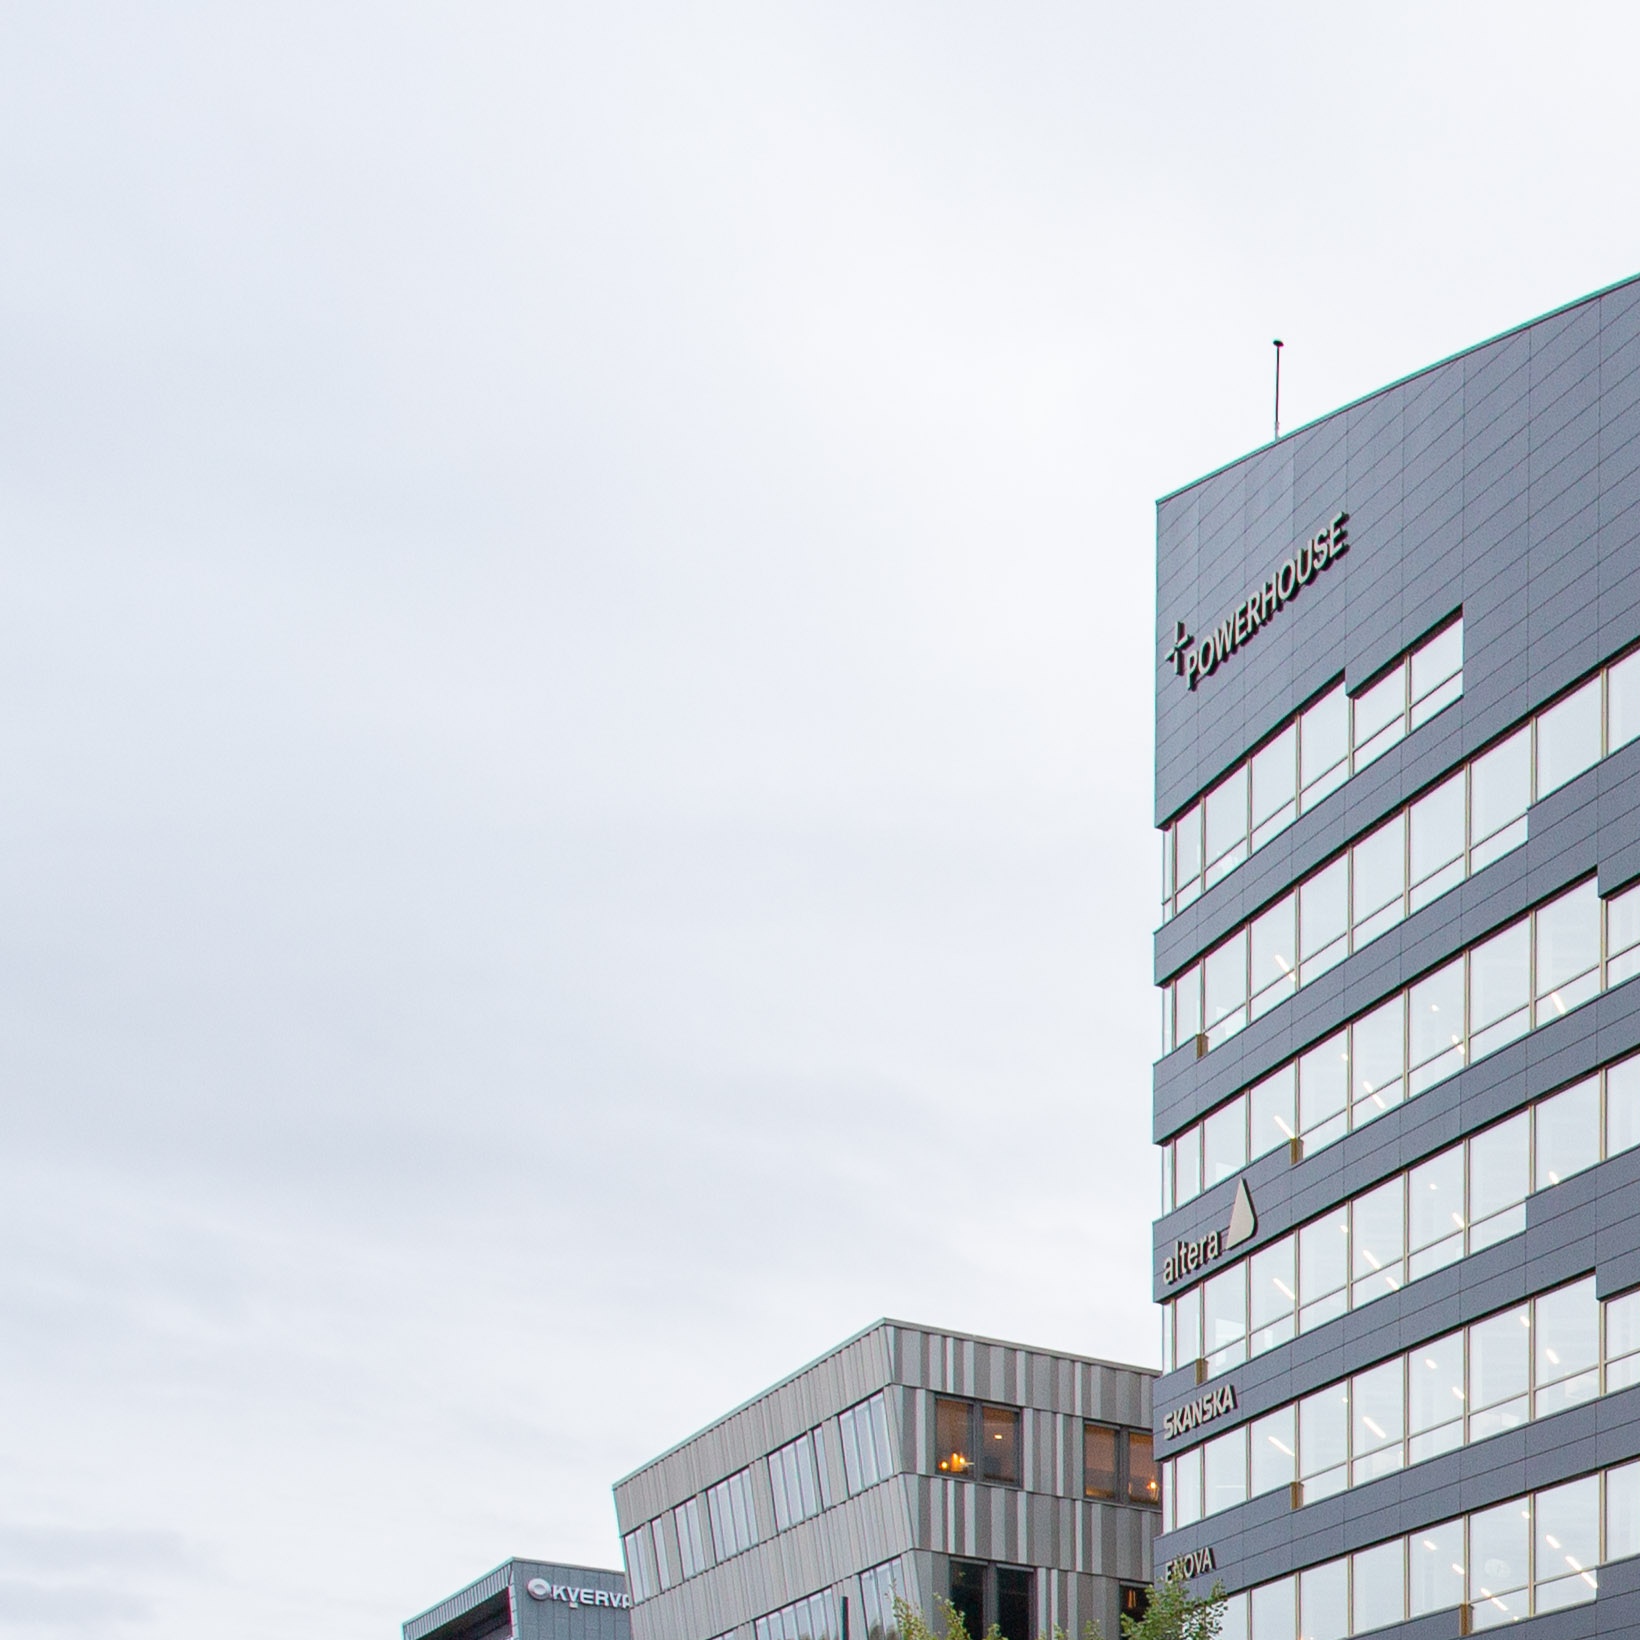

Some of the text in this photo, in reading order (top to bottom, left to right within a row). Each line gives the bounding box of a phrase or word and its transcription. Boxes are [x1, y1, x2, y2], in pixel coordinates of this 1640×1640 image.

[1187, 511, 1349, 691] POWERHOUSE
[1163, 1230, 1221, 1285] altera
[1163, 1384, 1236, 1440] SKANSKA
